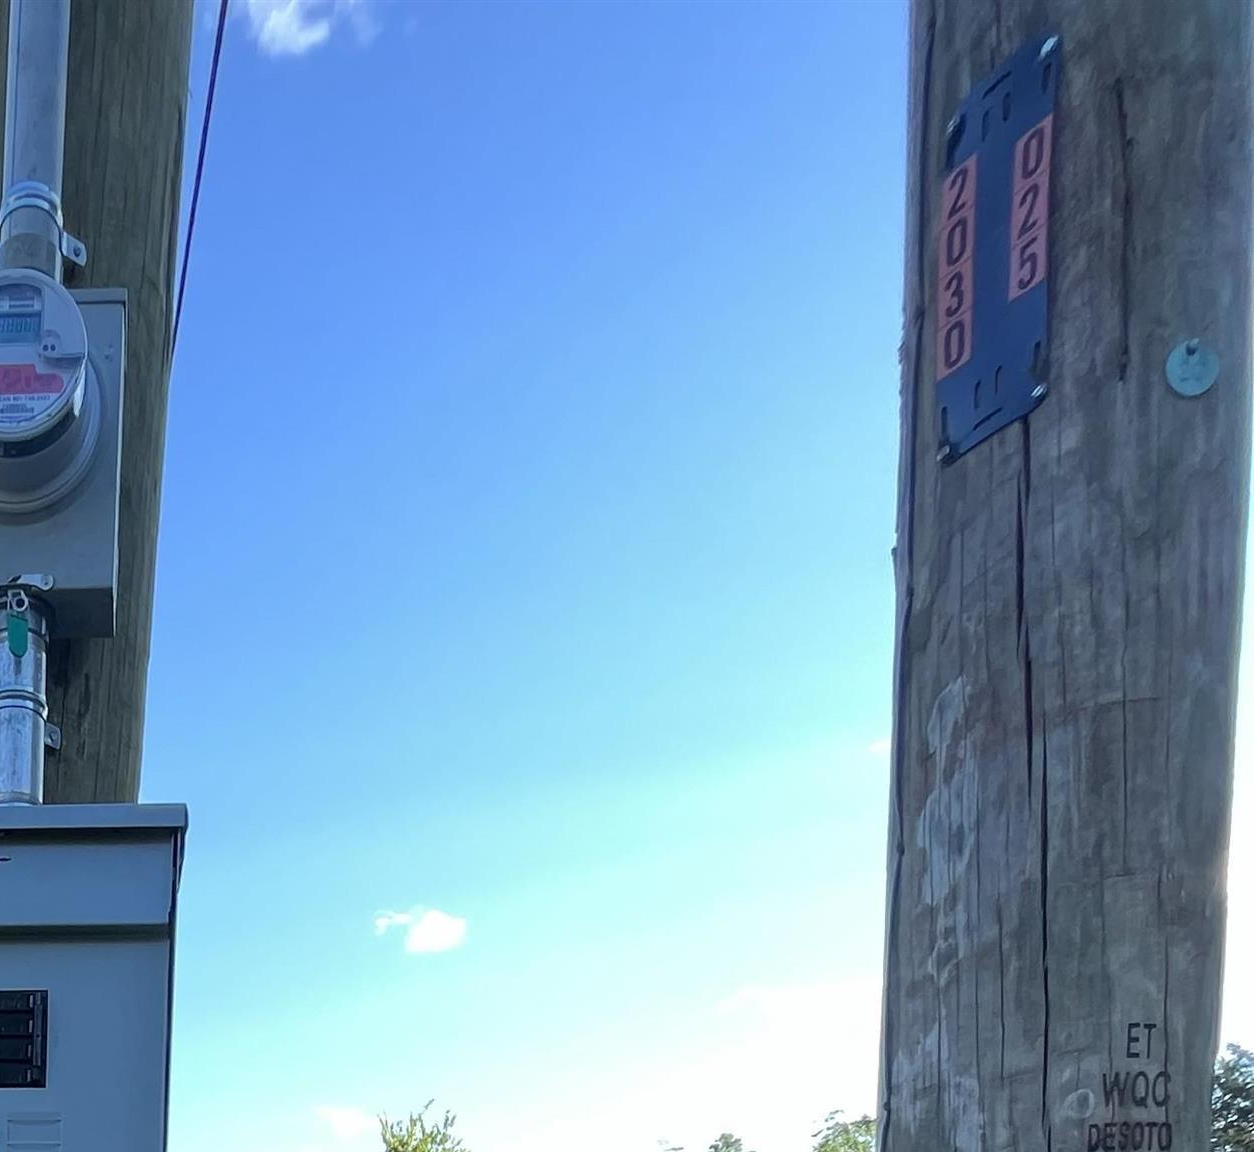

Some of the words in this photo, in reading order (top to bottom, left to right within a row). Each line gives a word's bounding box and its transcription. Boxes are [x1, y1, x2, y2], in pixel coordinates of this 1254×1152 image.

[945, 166, 969, 371] 2030
[1126, 1022, 1158, 1060] ET
[1087, 1121, 1173, 1152] DESOTO
